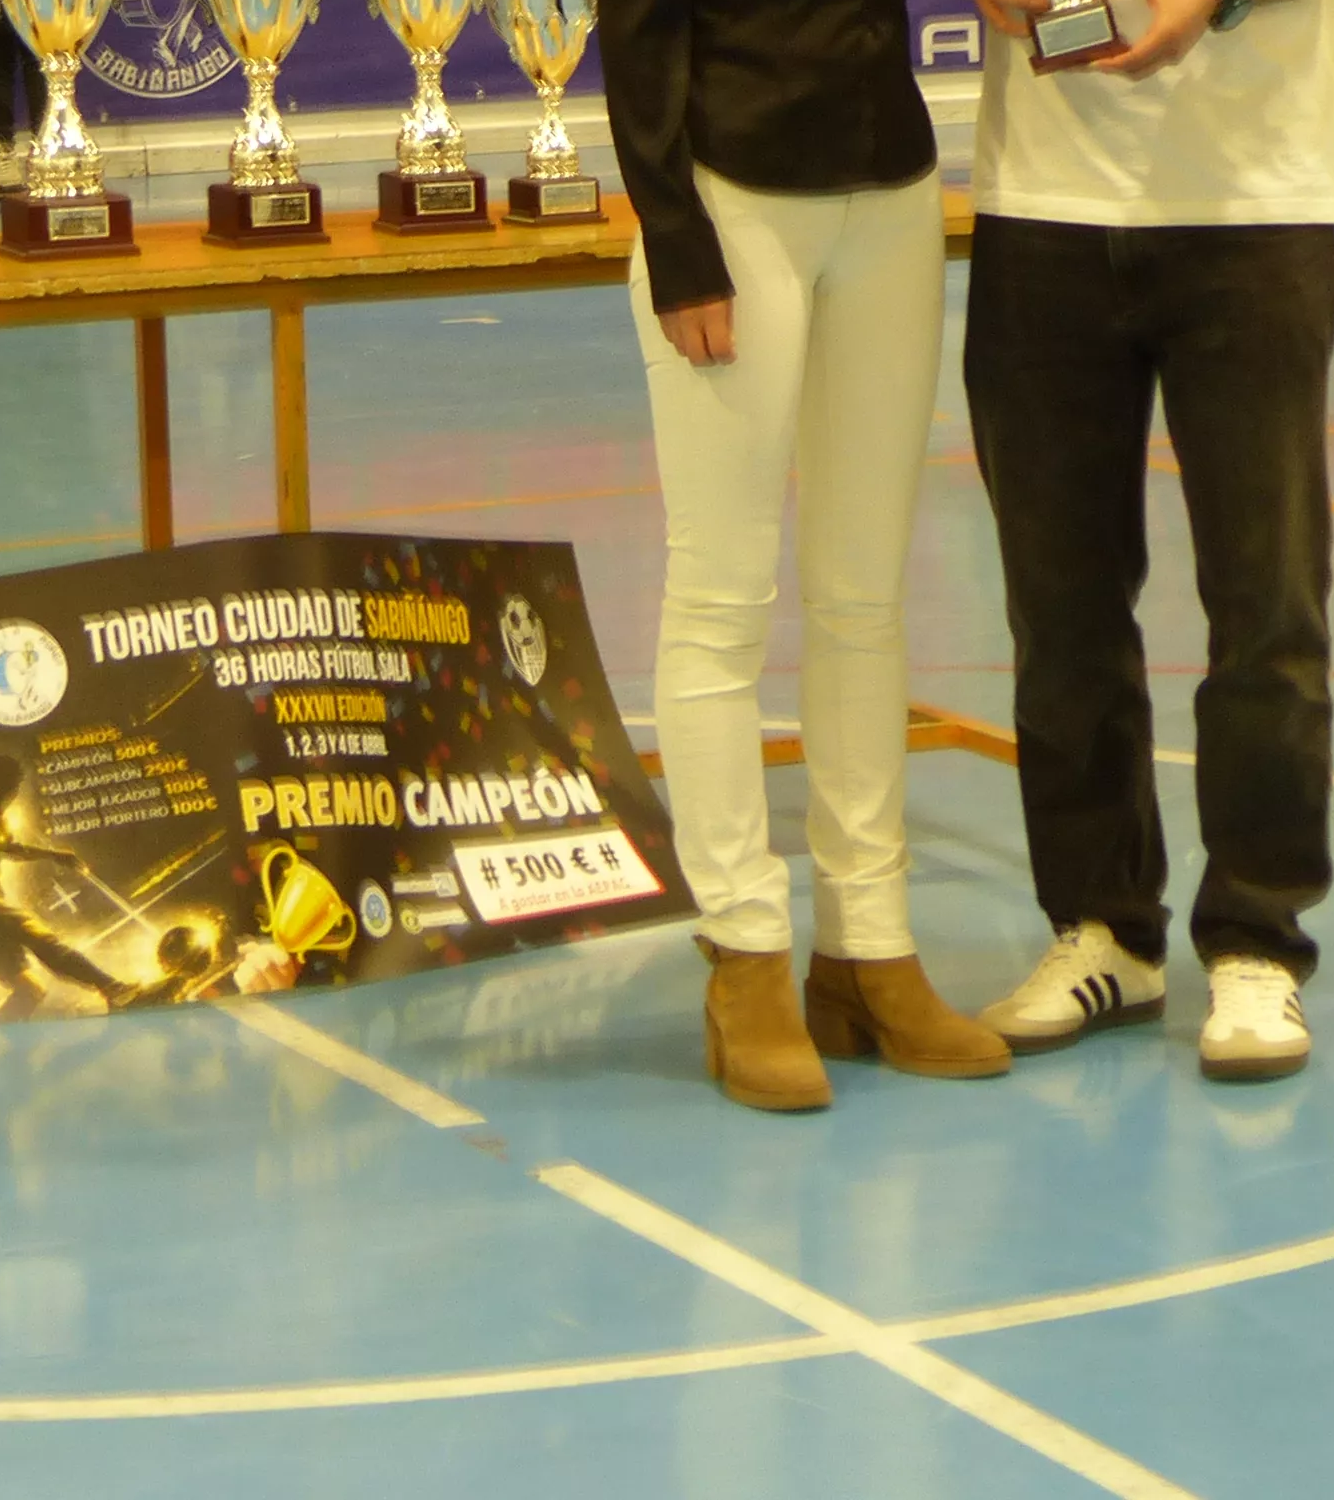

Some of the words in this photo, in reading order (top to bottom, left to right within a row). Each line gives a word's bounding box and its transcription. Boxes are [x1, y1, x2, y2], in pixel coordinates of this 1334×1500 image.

[83, 604, 220, 663] TORNEO
[223, 595, 334, 644] CIUDAD
[335, 596, 365, 639] DE
[214, 656, 248, 688] 36
[251, 650, 323, 684] HORAS
[323, 644, 379, 682] FÚTBOL
[378, 650, 412, 683] SALA
[239, 780, 397, 833] PREMIO
[403, 765, 602, 828] CAMPEÓN
[505, 852, 566, 887] 500
[570, 846, 599, 875] €
